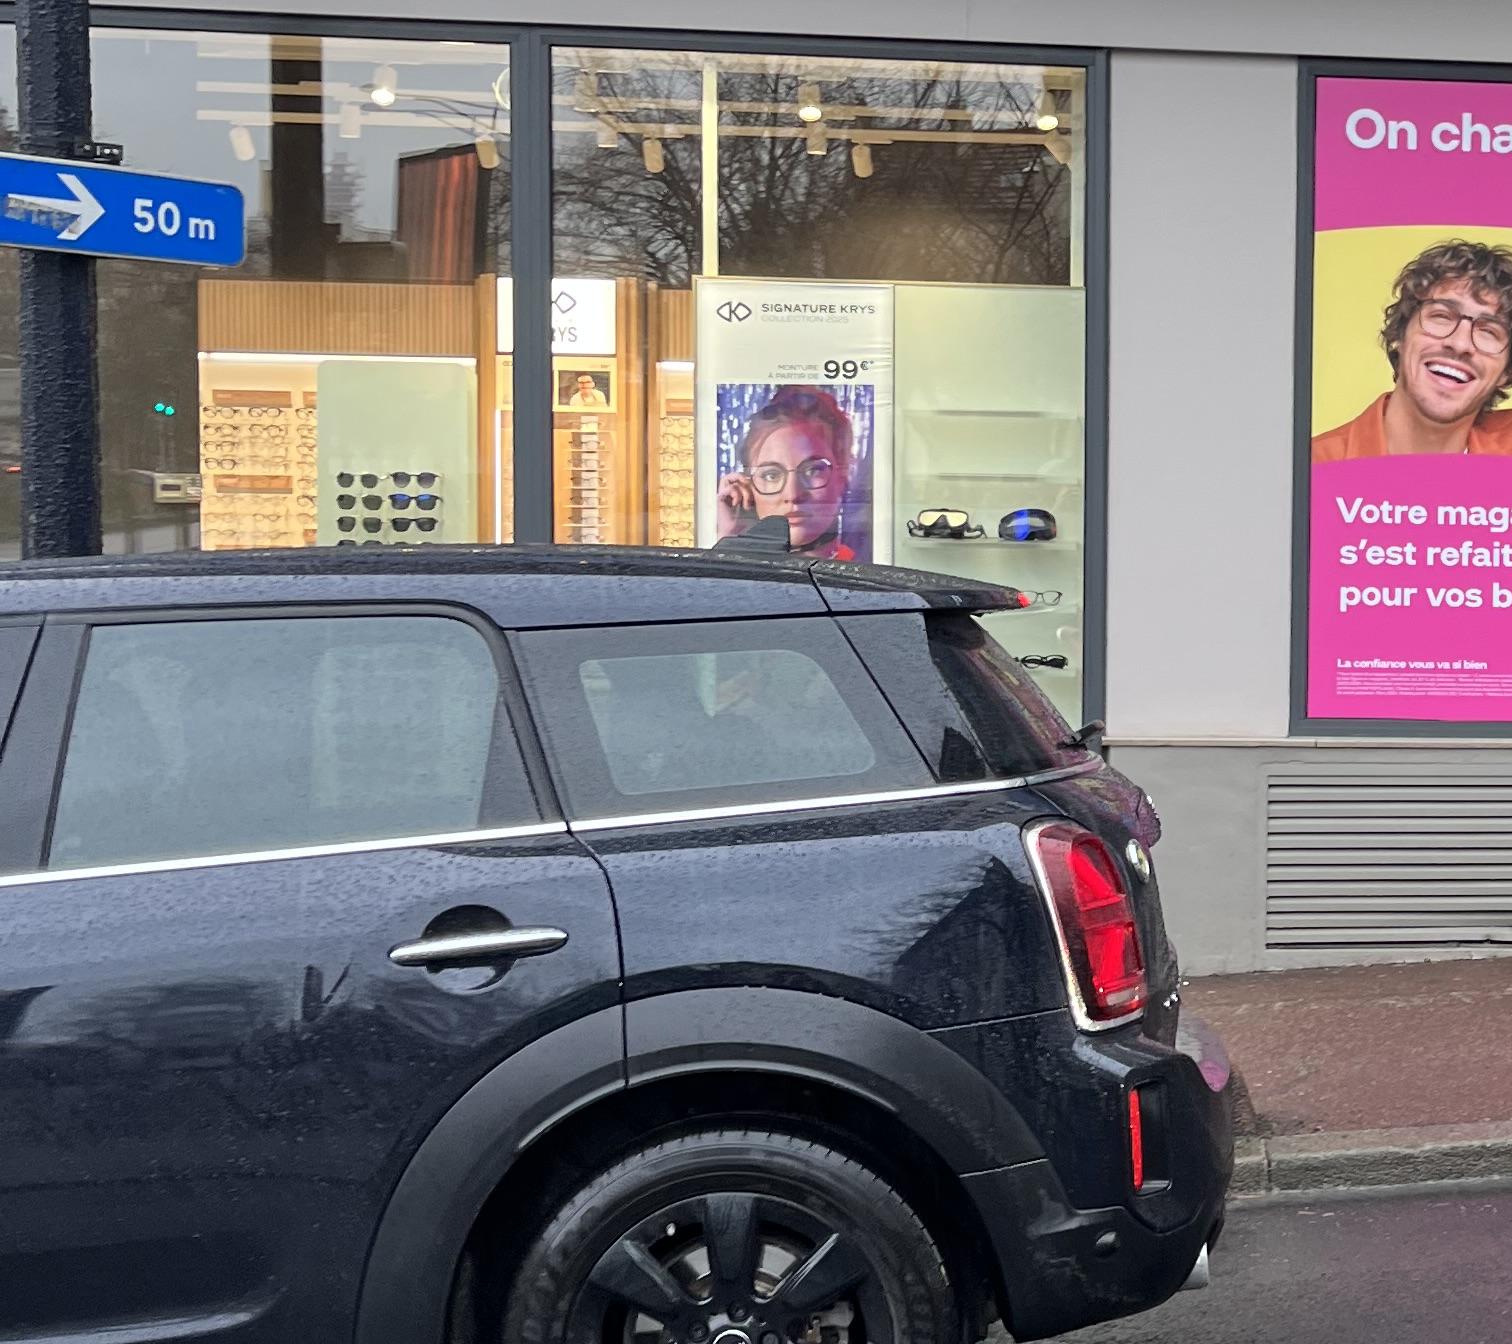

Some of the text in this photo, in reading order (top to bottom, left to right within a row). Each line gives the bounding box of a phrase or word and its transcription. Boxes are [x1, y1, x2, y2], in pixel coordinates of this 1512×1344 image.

[1345, 108, 1418, 151] On
[133, 198, 215, 240] 50 m
[761, 303, 875, 314] SIGNATURE KRYS
[1335, 497, 1428, 526] Votre
[1339, 538, 1417, 567] s'est
[1425, 541, 1512, 568] refait
[1339, 583, 1419, 613] pour
[1426, 587, 1483, 610] vos
[1336, 658, 1488, 670] La confiance vous va si bien
